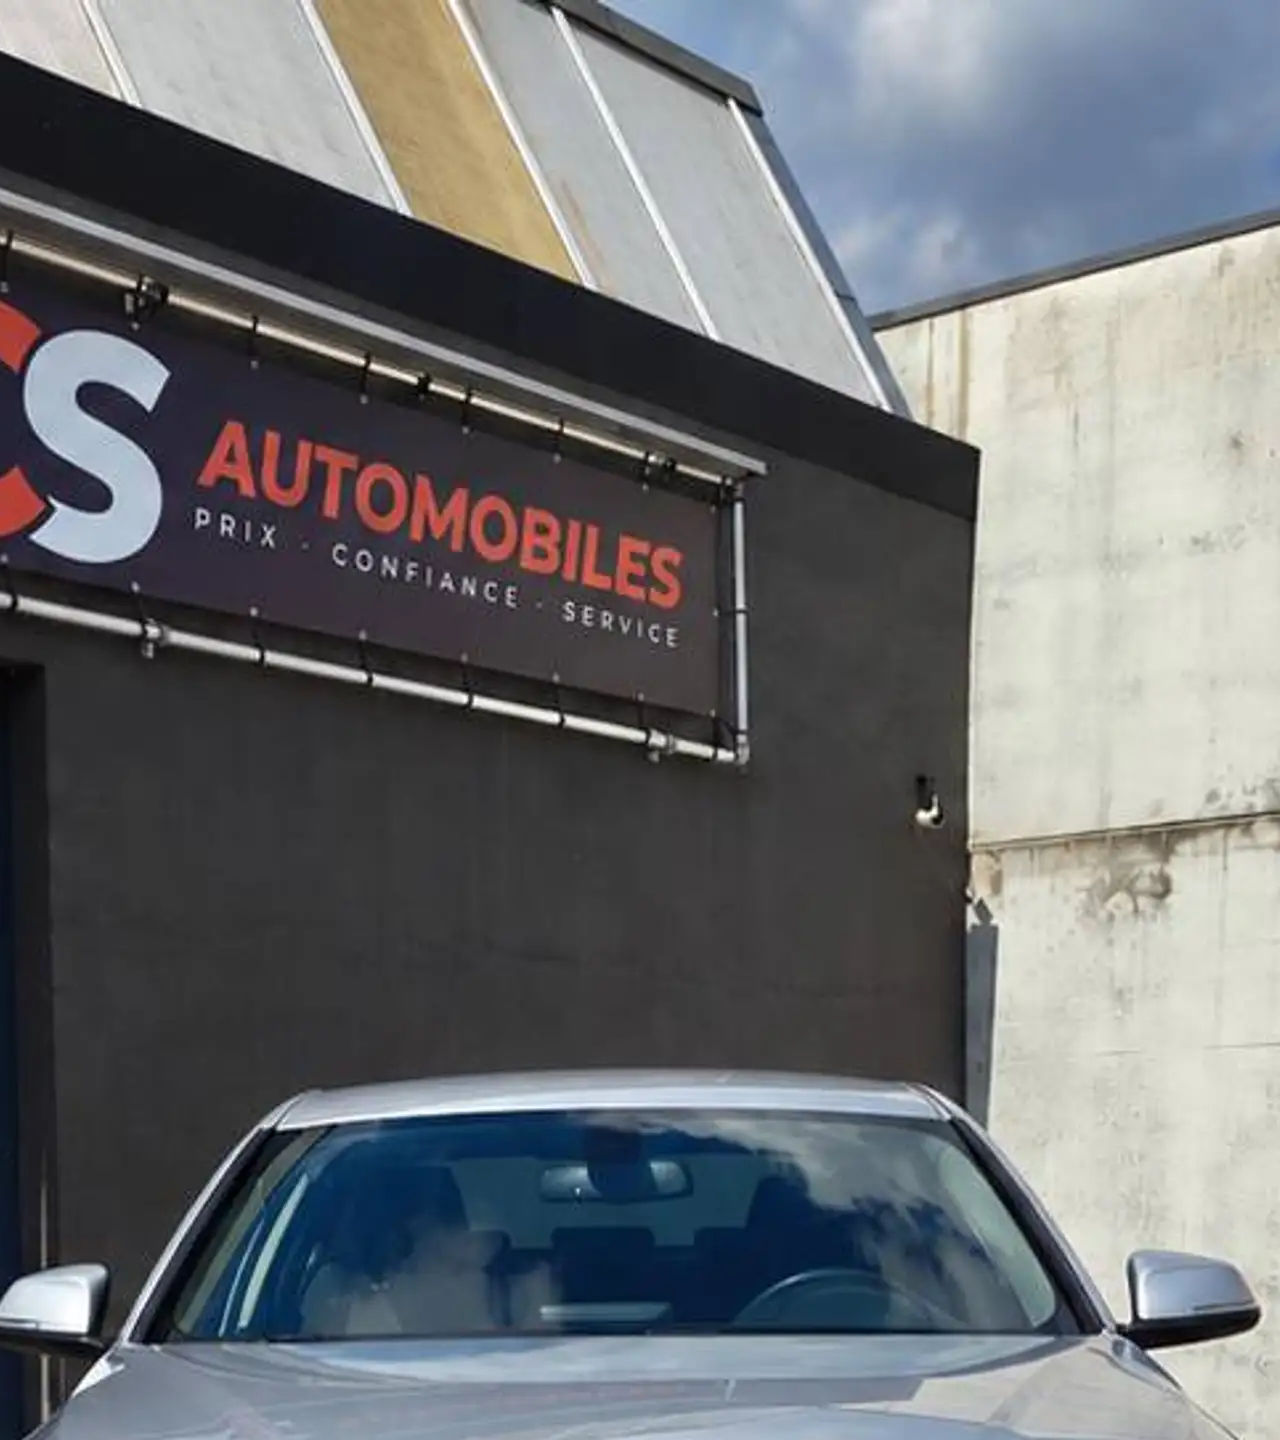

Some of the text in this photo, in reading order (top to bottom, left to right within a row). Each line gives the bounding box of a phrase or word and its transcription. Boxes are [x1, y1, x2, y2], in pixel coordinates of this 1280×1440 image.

[194, 507, 680, 647] PRIX CONFIANCE SERVICE
[197, 420, 684, 610] AUTOMOBILES
